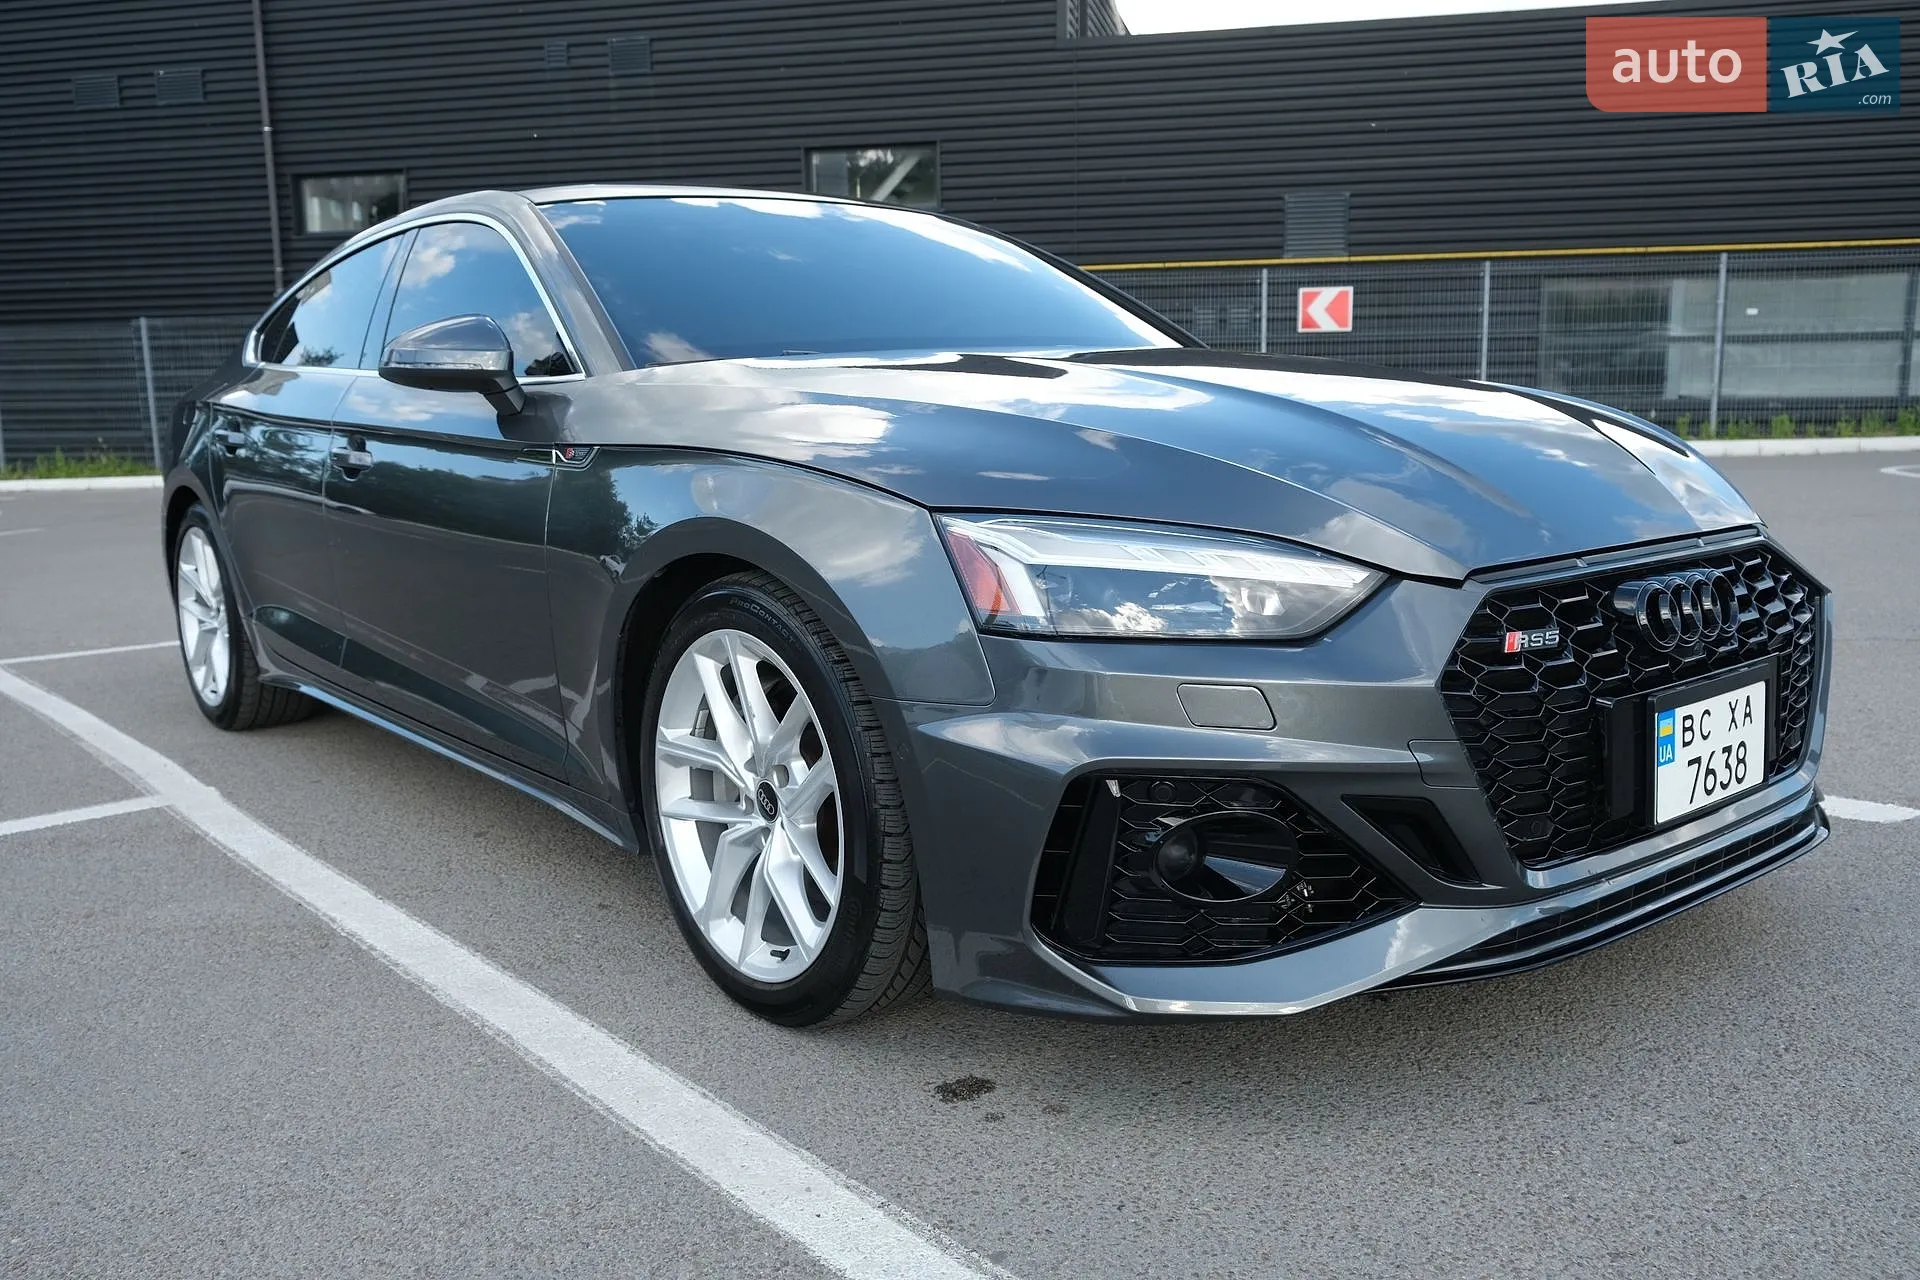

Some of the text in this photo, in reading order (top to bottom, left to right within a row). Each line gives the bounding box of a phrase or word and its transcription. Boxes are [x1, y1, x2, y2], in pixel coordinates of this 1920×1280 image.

[1514, 630, 1560, 649] RS5
[1682, 695, 1753, 748] BC XA
[1659, 743, 1673, 763] UA
[1687, 740, 1747, 805] 7638
